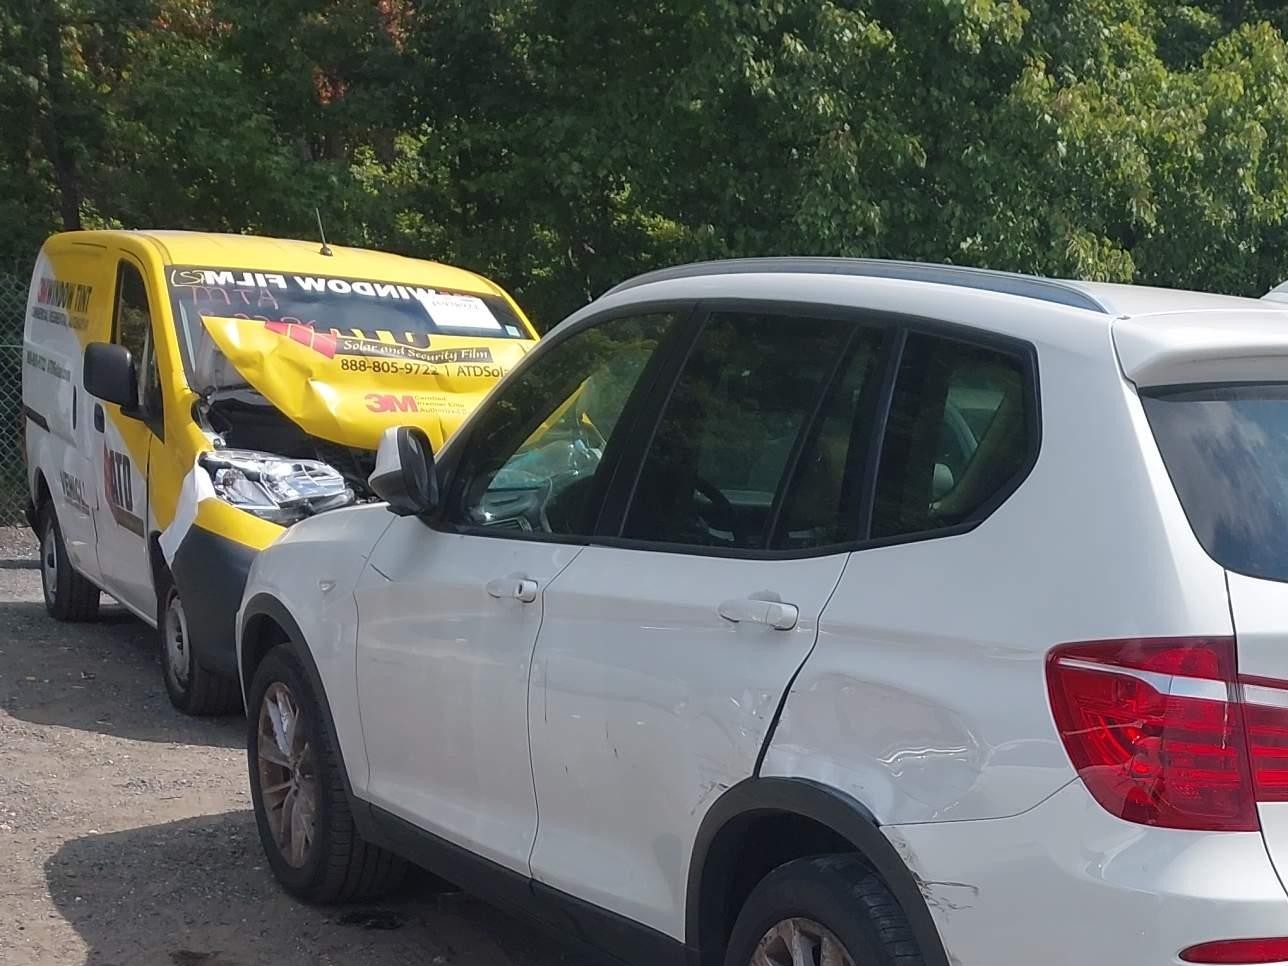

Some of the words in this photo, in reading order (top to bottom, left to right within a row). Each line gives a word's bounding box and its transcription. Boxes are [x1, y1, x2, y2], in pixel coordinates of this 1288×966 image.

[343, 340, 378, 353] Solar
[380, 347, 405, 357] and
[408, 348, 458, 362] Security
[461, 349, 489, 360] Film
[340, 358, 440, 376] 888-805-9722
[364, 393, 418, 413] 3M
